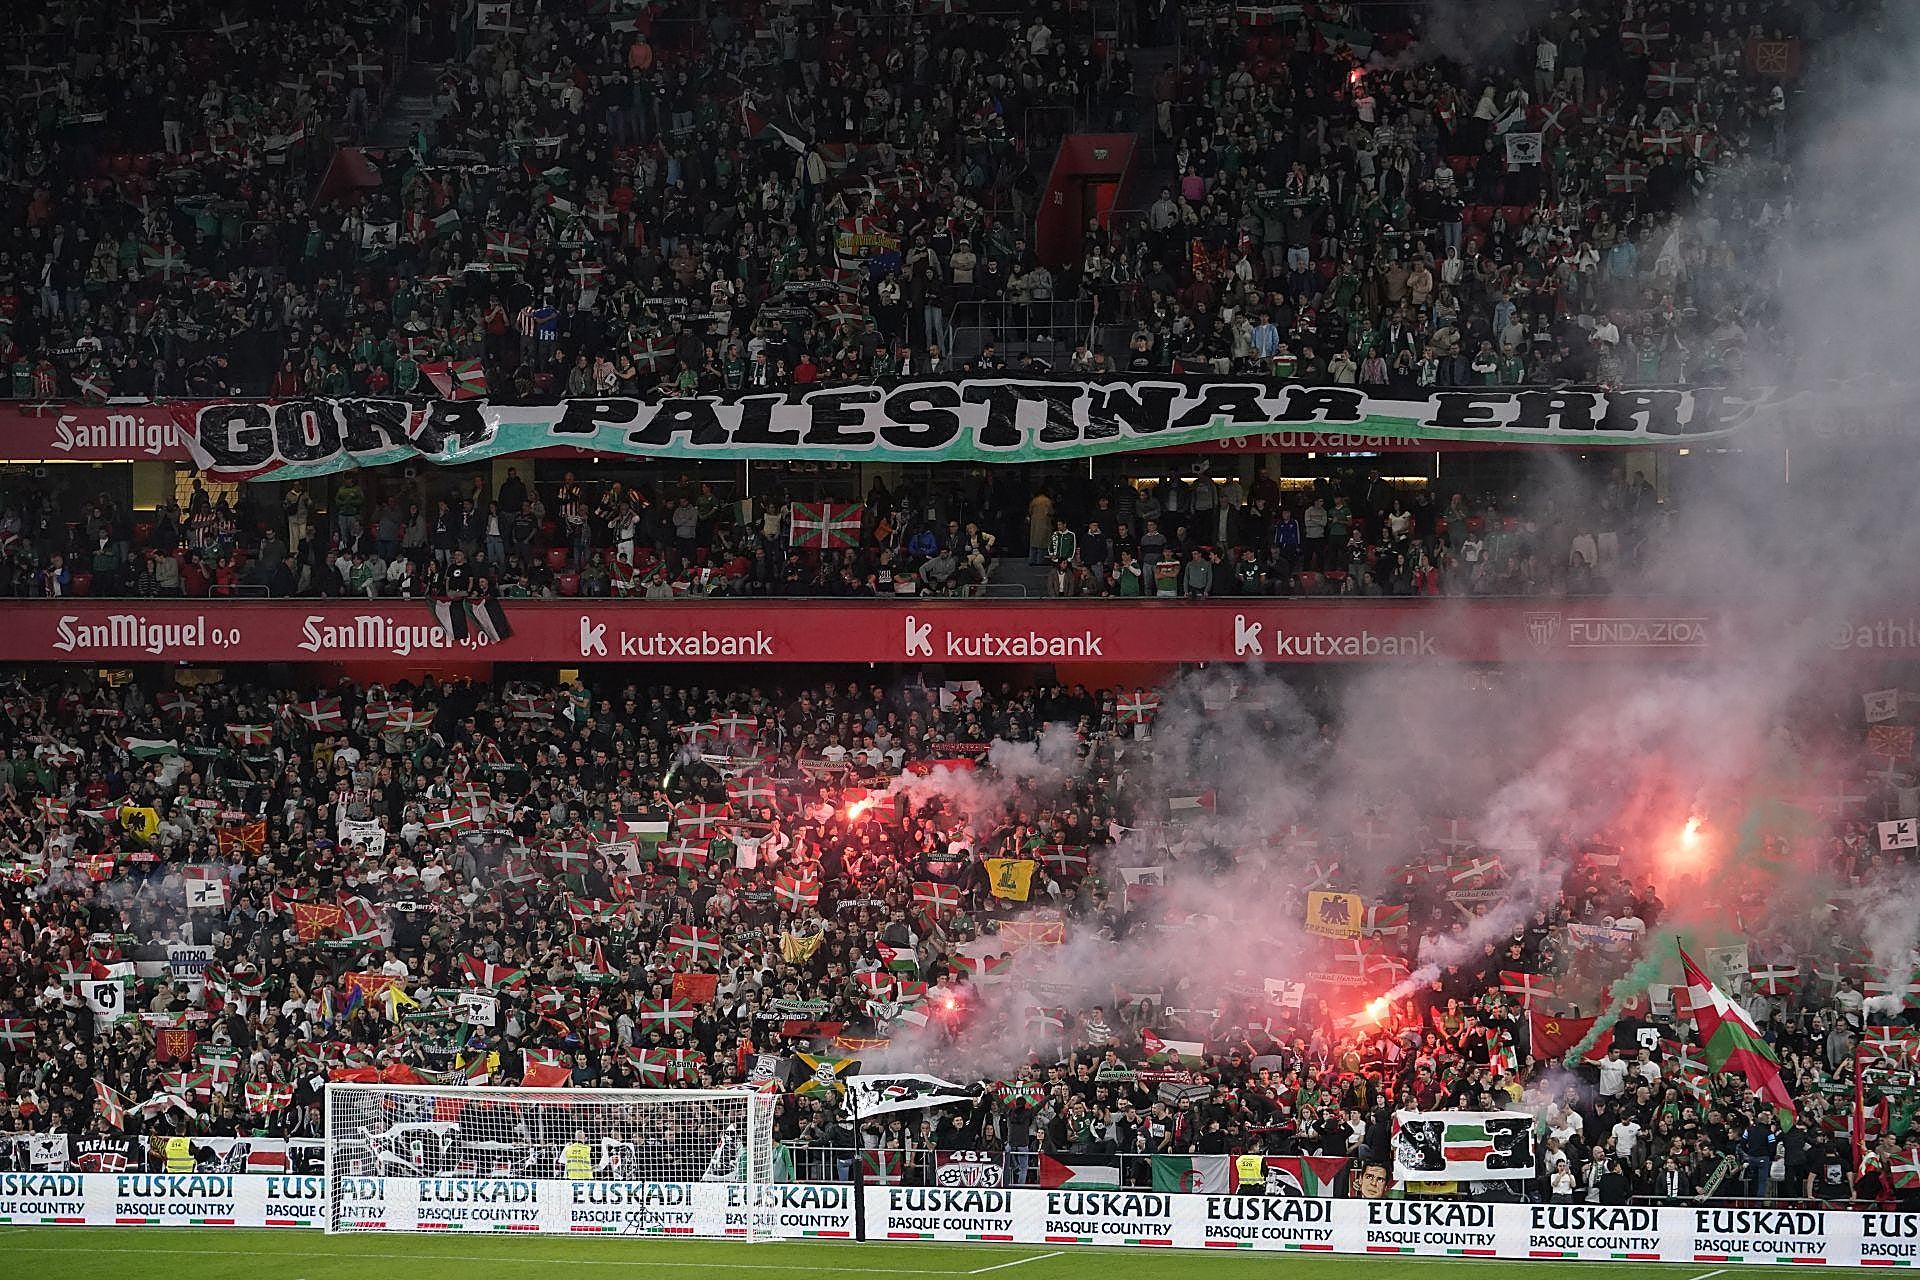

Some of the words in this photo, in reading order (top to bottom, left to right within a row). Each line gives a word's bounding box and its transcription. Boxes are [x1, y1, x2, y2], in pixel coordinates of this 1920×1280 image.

[199, 399, 488, 467] GORA
[552, 384, 1360, 449] PALESTINAR
[51, 415, 184, 453] SanMigu
[1570, 624, 1707, 641] FUNDAZIOA
[621, 631, 773, 656] kutxabank
[947, 631, 1103, 656] kutxabank
[1277, 631, 1435, 657] kutxabank
[76, 1139, 130, 1153] TAFALLA
[949, 1150, 992, 1161] 481
[117, 1176, 233, 1198] EUSKADI
[418, 1180, 538, 1203] EUSKADI
[571, 1182, 693, 1206] EUSKADI
[19, 1203, 85, 1214] COUNTRY
[889, 1189, 1011, 1212] EUSKADI
[1047, 1191, 1172, 1217] EUSKADI
[116, 1203, 165, 1216] BASQUE
[168, 1203, 234, 1216] COUNTRY
[266, 1204, 316, 1217] BASQUE
[417, 1207, 471, 1221] BASQUE
[473, 1208, 539, 1221] COUNTRY
[571, 1209, 623, 1223] BASQUE
[1207, 1197, 1332, 1222] EUSKADI
[1368, 1202, 1495, 1227] EUSKADI
[780, 1215, 849, 1228] COUNTRY
[889, 1217, 941, 1230] BASQUE
[944, 1218, 1013, 1231] COUNTRY
[1531, 1206, 1659, 1232] EUSKADI
[1696, 1209, 1826, 1235] EUSKADI
[1046, 1221, 1098, 1234] BASQUE
[1101, 1222, 1172, 1235] COUNTRY
[1206, 1226, 1259, 1239] BASQUE
[1262, 1228, 1333, 1241] COUNTRY
[1367, 1231, 1421, 1244] BASQUE
[1424, 1232, 1496, 1246] COUNTRY
[1529, 1236, 1585, 1249] BASQUE
[1588, 1237, 1660, 1250] COUNTRY
[1695, 1239, 1750, 1253] BASQUE
[1753, 1240, 1826, 1254] COUNTRY
[1862, 1243, 1917, 1257] BASQUE
